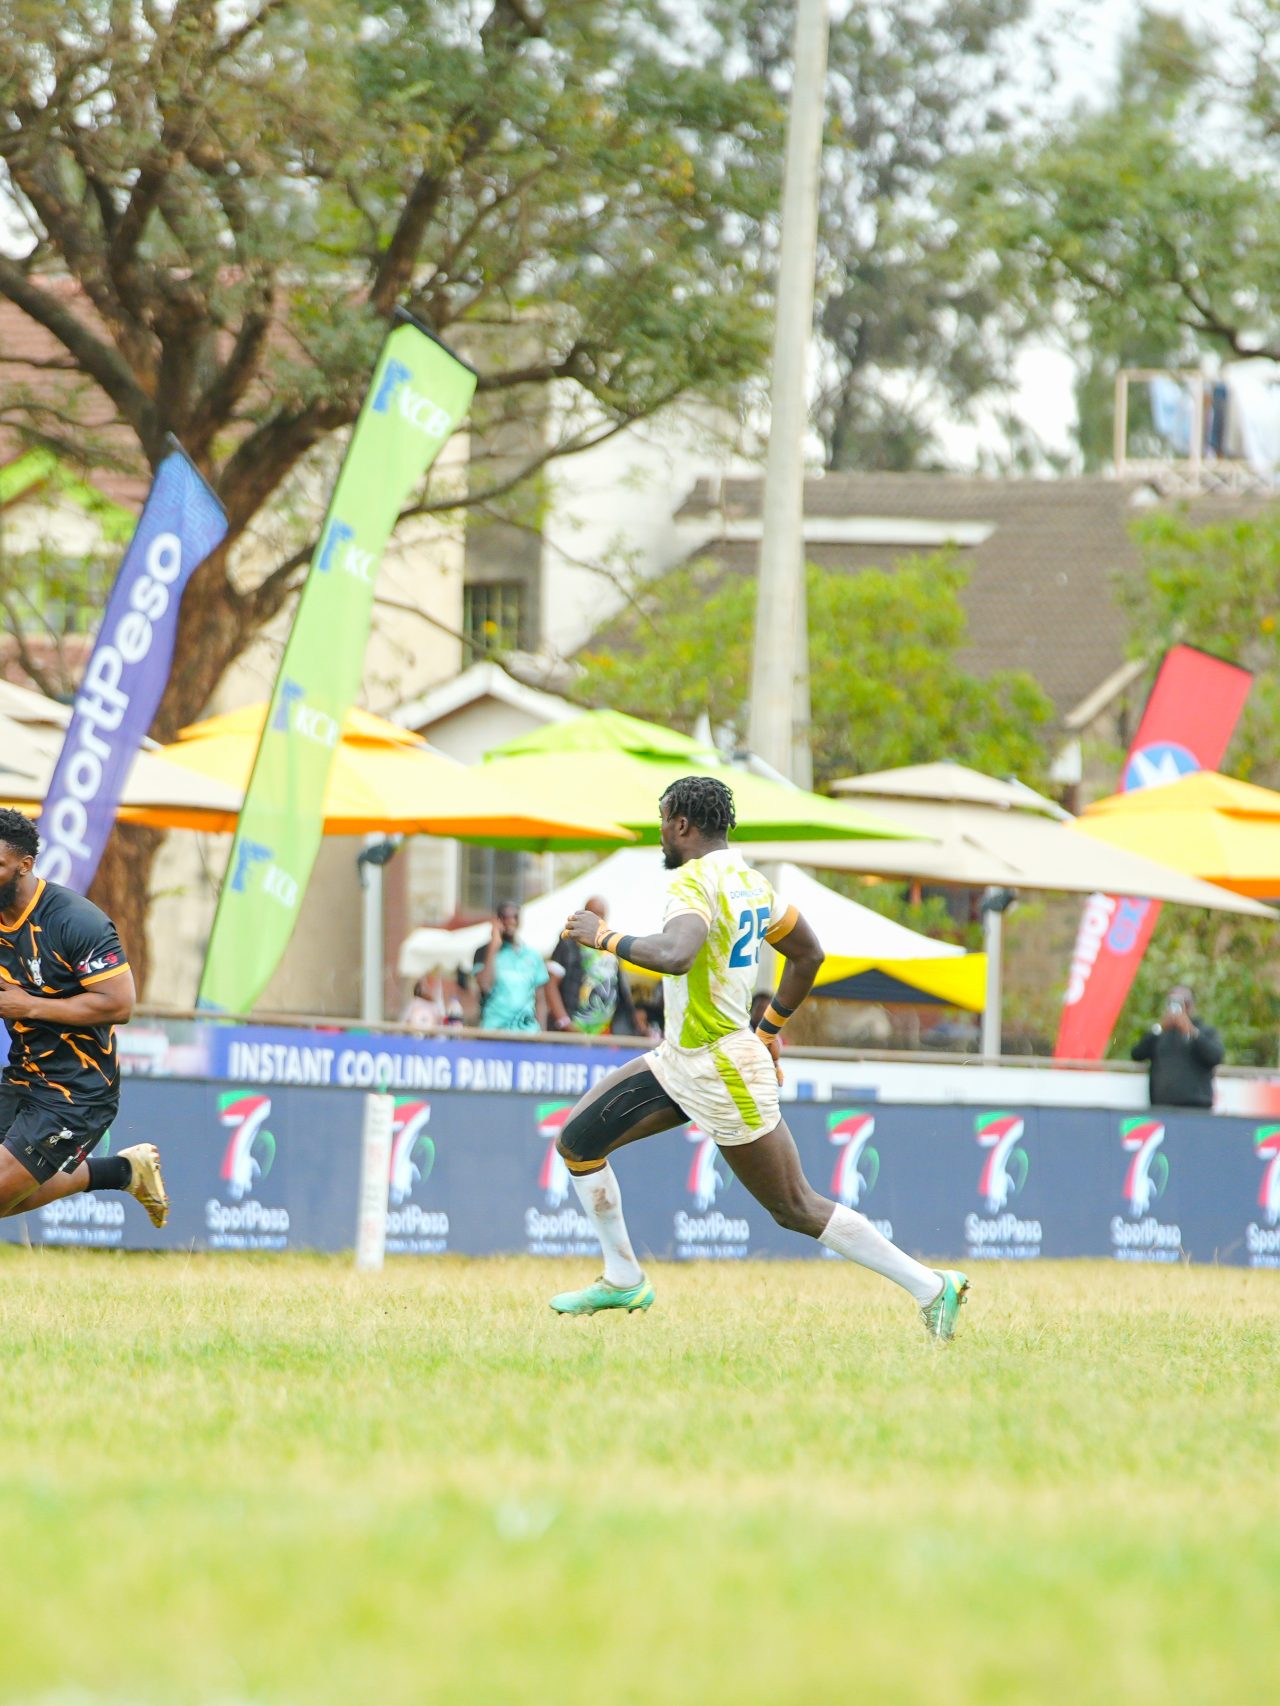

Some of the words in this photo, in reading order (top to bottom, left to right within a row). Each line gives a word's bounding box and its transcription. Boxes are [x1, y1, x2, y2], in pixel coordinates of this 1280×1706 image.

[398, 385, 452, 438] KCB
[728, 906, 771, 969] 25
[228, 1041, 335, 1083] INSTANT
[337, 1048, 453, 1090] COOLING
[456, 1056, 514, 1092] PAIN
